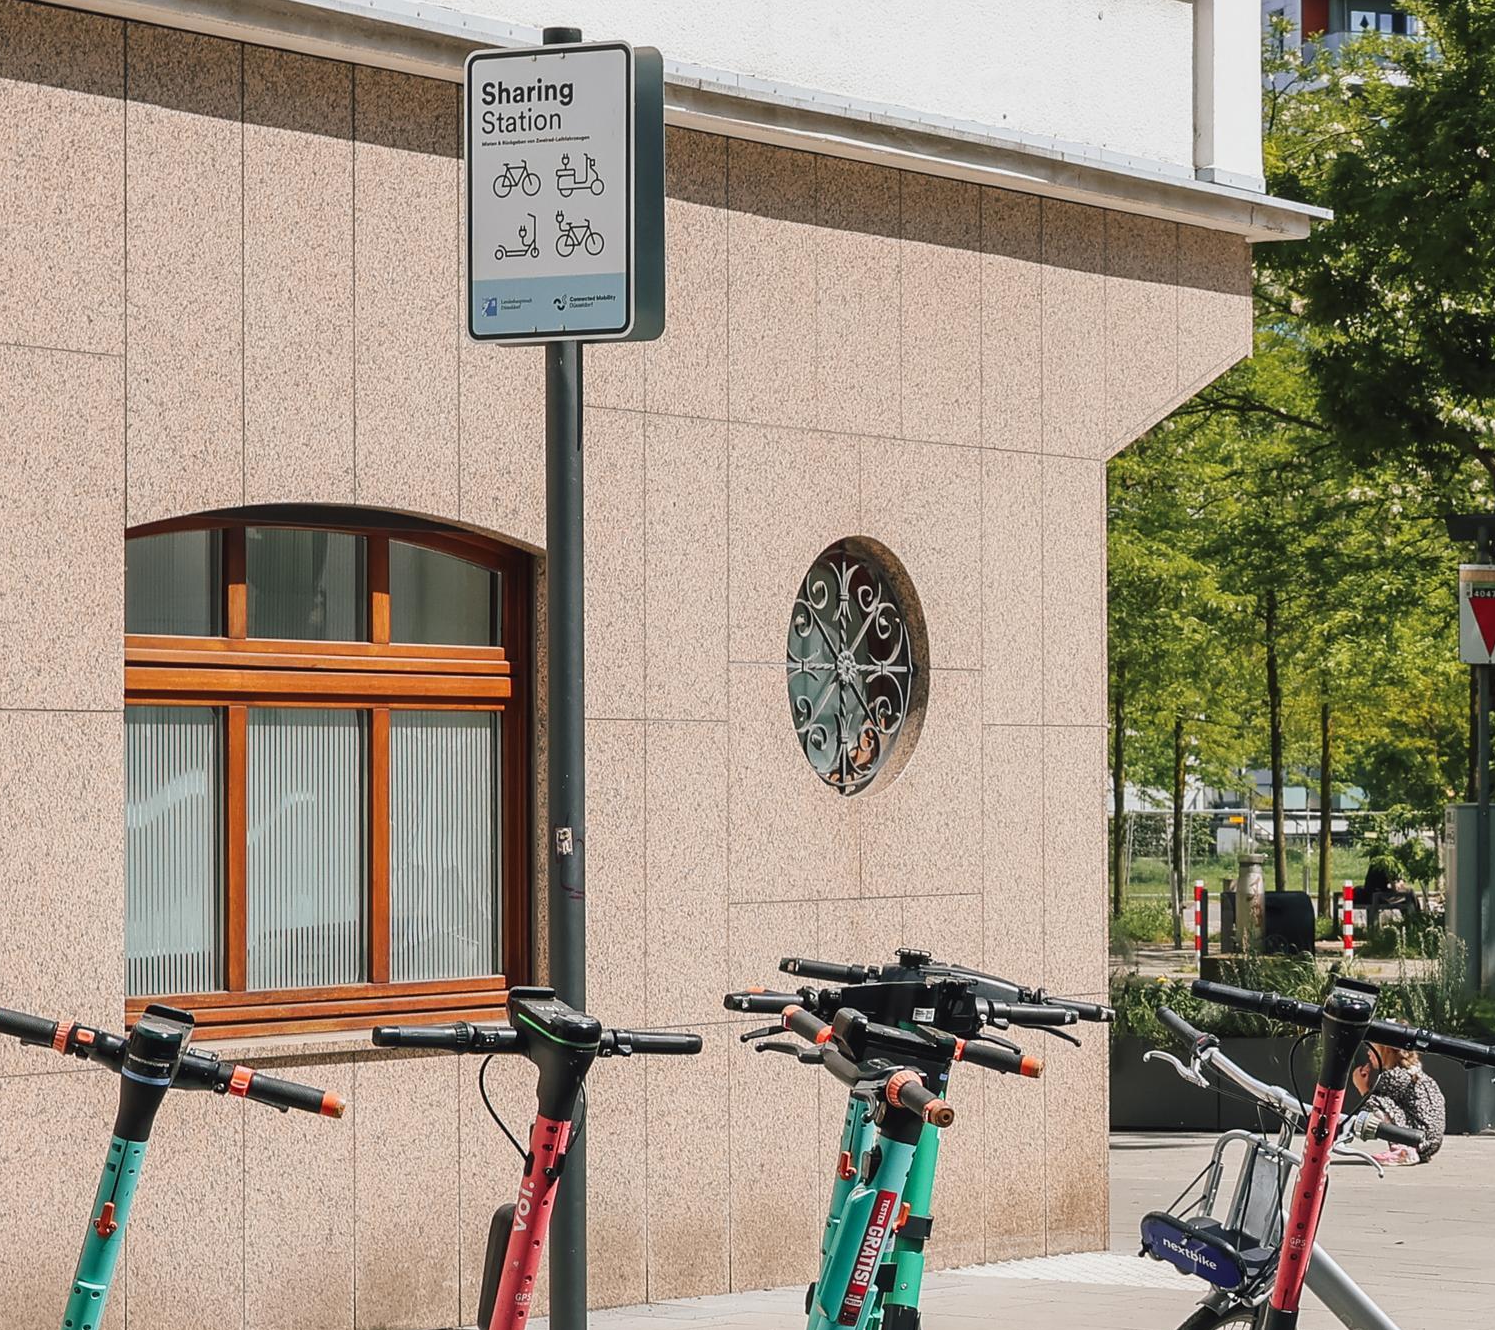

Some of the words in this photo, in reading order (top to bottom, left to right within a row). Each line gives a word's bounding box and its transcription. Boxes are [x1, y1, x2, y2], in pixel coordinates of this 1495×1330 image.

[481, 78, 574, 106] Sharing
[481, 109, 562, 135] Station
[513, 1180, 535, 1233] voi.
[852, 1225, 885, 1287] GRATIS!
[1162, 1238, 1218, 1271] nextbike
[515, 1292, 532, 1302] GPS
